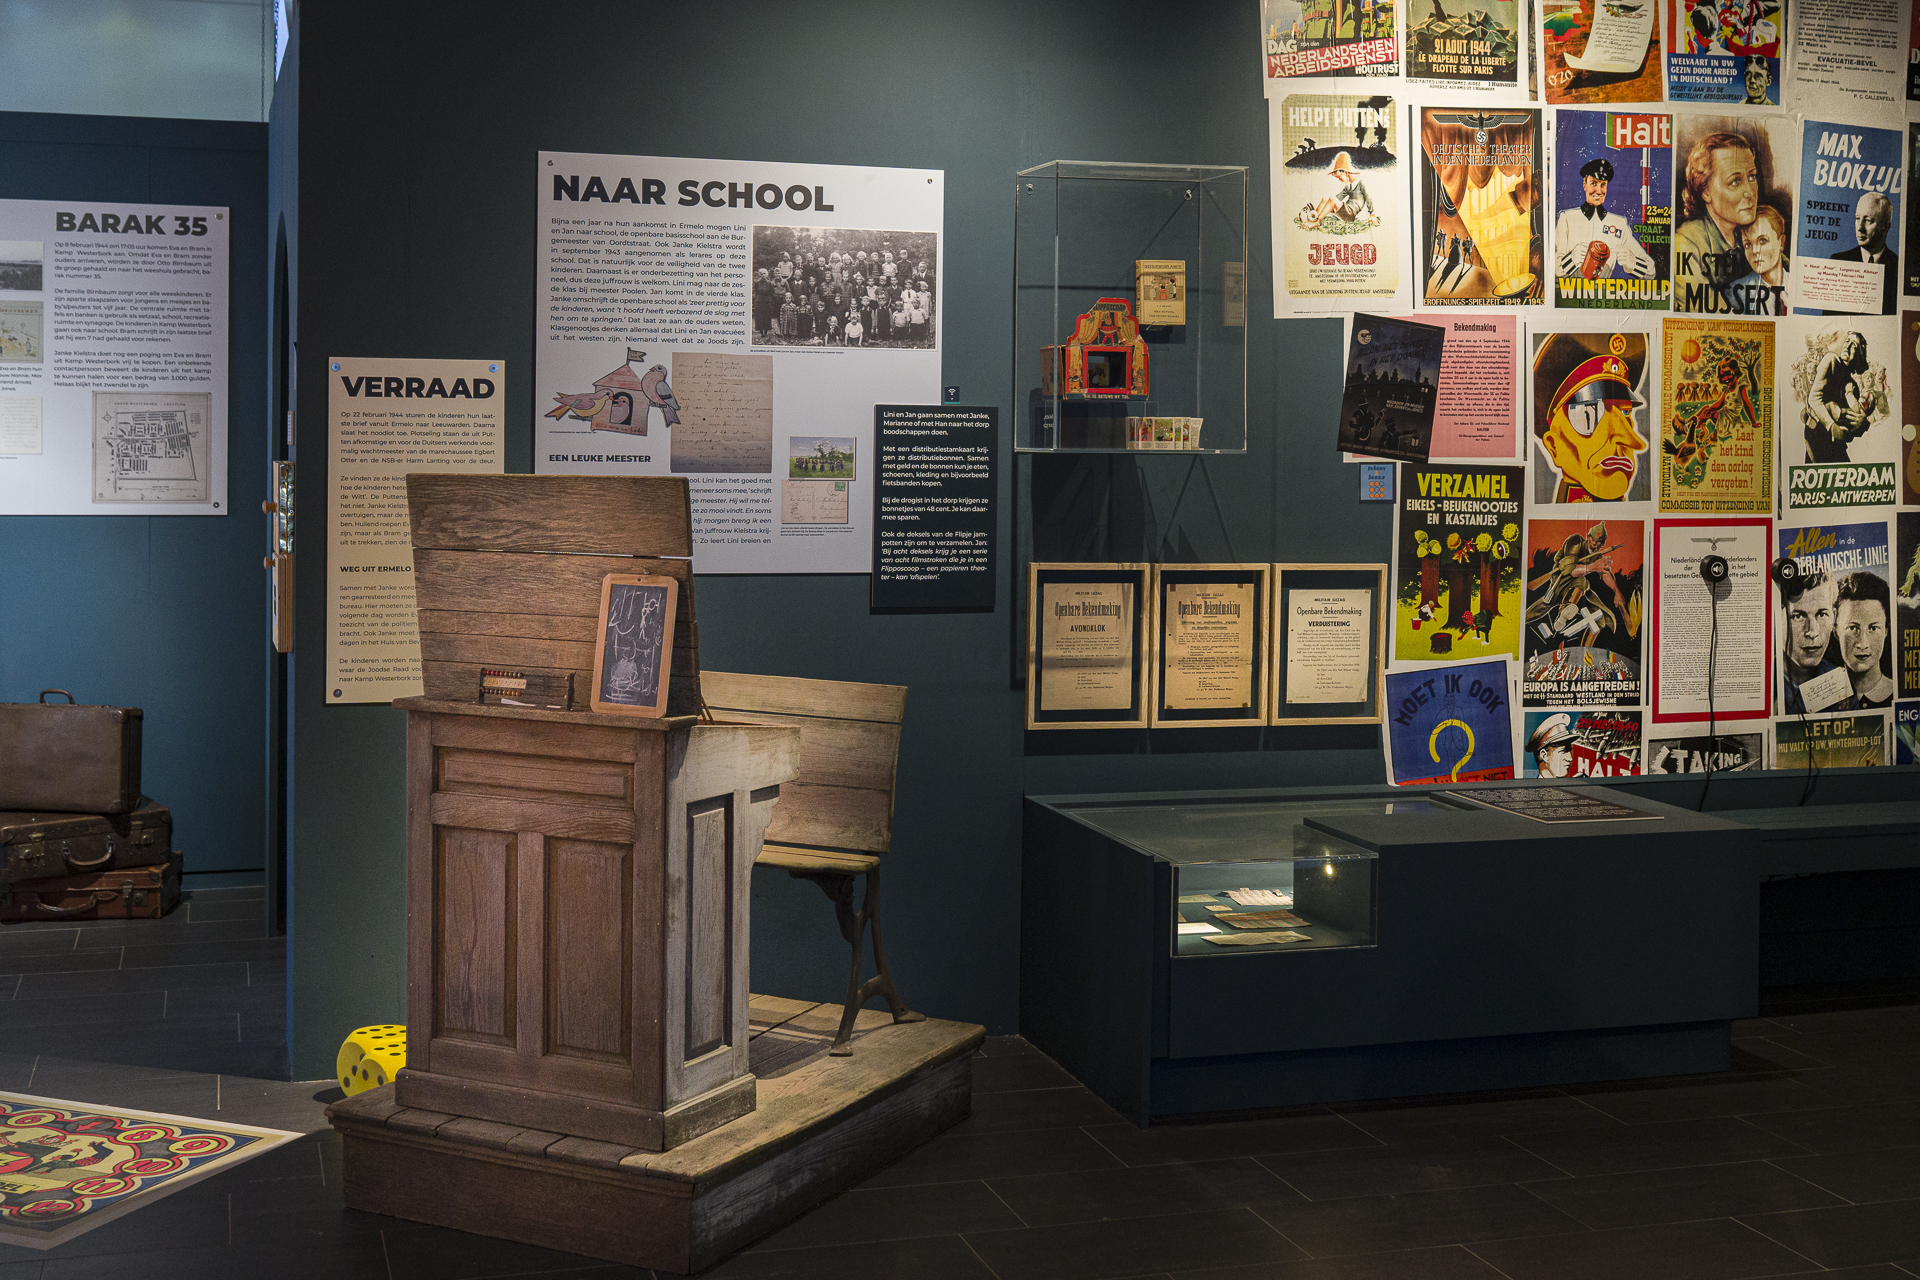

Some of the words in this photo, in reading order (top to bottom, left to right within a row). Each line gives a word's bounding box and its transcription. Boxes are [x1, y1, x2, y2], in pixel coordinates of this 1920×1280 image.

[1267, 39, 1297, 54] DAG
[1270, 38, 1393, 67] NEDERLANDSCHEN
[1434, 39, 1443, 53] 21
[1445, 39, 1467, 54] AOUT
[1470, 40, 1491, 56] 1944
[1274, 50, 1394, 78] ARBEIDSDIENST
[1418, 53, 1426, 62] LE
[1428, 54, 1458, 64] DRAPEAU
[1460, 56, 1469, 64] DE
[1471, 56, 1479, 65] LA
[1671, 58, 1708, 66] WELVAART
[1817, 56, 1877, 67] EVACUATIE-BEVEL
[1355, 64, 1398, 74] HOUTRUST
[1432, 64, 1457, 73] FLOTTE
[1459, 65, 1472, 74] SUR
[1474, 66, 1493, 75] PARIS
[1670, 66, 1690, 74] GEZIN
[1680, 75, 1728, 83] DUITSCHLAND
[1289, 107, 1330, 127] HELPT
[1616, 116, 1669, 145] Halt
[1432, 144, 1486, 155] DEUTSCHES
[1489, 144, 1531, 155] THEATER
[1816, 131, 1862, 160] MAX
[1432, 155, 1442, 165] IN
[1444, 155, 1462, 165] DEN
[1464, 155, 1531, 166] NIEDERLANDEN
[553, 174, 666, 205] NAAR
[678, 180, 835, 212] SCHOOL
[1806, 200, 1850, 213] SPREEKT
[56, 212, 166, 236] BARAK
[174, 216, 208, 237] 35
[1806, 215, 1825, 225] TOT
[1828, 216, 1840, 227] DE
[1633, 224, 1664, 234] STRAAT-
[1805, 229, 1838, 241] JEUGD
[1308, 243, 1377, 265] JEUGD
[1676, 252, 1693, 276] IK
[1558, 278, 1670, 301] WINTERHULP
[1578, 300, 1653, 309] NEDERLAND
[1685, 283, 1785, 316] MUSSERT
[1454, 322, 1497, 333] Bekendmaking
[341, 376, 495, 399] VERRAAD
[1735, 429, 1754, 441] Laat
[1719, 444, 1733, 456] het
[1734, 444, 1754, 456] kind
[549, 453, 569, 463] EEN
[571, 453, 603, 463] LEUKE
[606, 454, 651, 463] MEESTER
[1711, 459, 1726, 472] den
[1728, 460, 1754, 475] oorlog
[1762, 440, 1771, 499] NEDERLANDSCHE
[1790, 466, 1895, 489] ROTTERDAM
[1416, 472, 1509, 498] VERZAMEL
[1661, 500, 1699, 510] COMMISSIE
[1701, 501, 1714, 510] TOT
[1715, 501, 1754, 510] UITZENDING
[1755, 501, 1770, 510] VAN
[1427, 513, 1439, 524] EN
[1445, 513, 1497, 526] KASTANJES
[1785, 528, 1836, 559] Allen
[1846, 536, 1855, 544] de
[1864, 545, 1888, 567] UNIE
[340, 565, 361, 573] WEG
[362, 565, 377, 573] UIT
[377, 565, 411, 573] ERMELO
[1055, 601, 1081, 620] Openbare
[1082, 601, 1121, 619] Bekendmaking
[1297, 606, 1323, 616] Openbare
[1324, 606, 1362, 616] Bekendmaking
[1070, 624, 1106, 632] AVONDKLOK
[1523, 682, 1559, 692] EUROPA
[1559, 682, 1569, 692] IS
[1393, 679, 1436, 727] MOET
[1444, 674, 1463, 694] IK
[1469, 680, 1505, 715] OOK
[1576, 718, 1591, 729] 28
[1592, 719, 1610, 730] MEI
[1612, 720, 1638, 732] 1940
[1805, 722, 1830, 737] LET
[1833, 717, 1855, 735] OP!
[130, 1130, 157, 1142] 8
[178, 1140, 209, 1152] 9
[128, 1160, 166, 1173] 10
[77, 1179, 120, 1193] 11
[24, 1201, 70, 1213] 12
